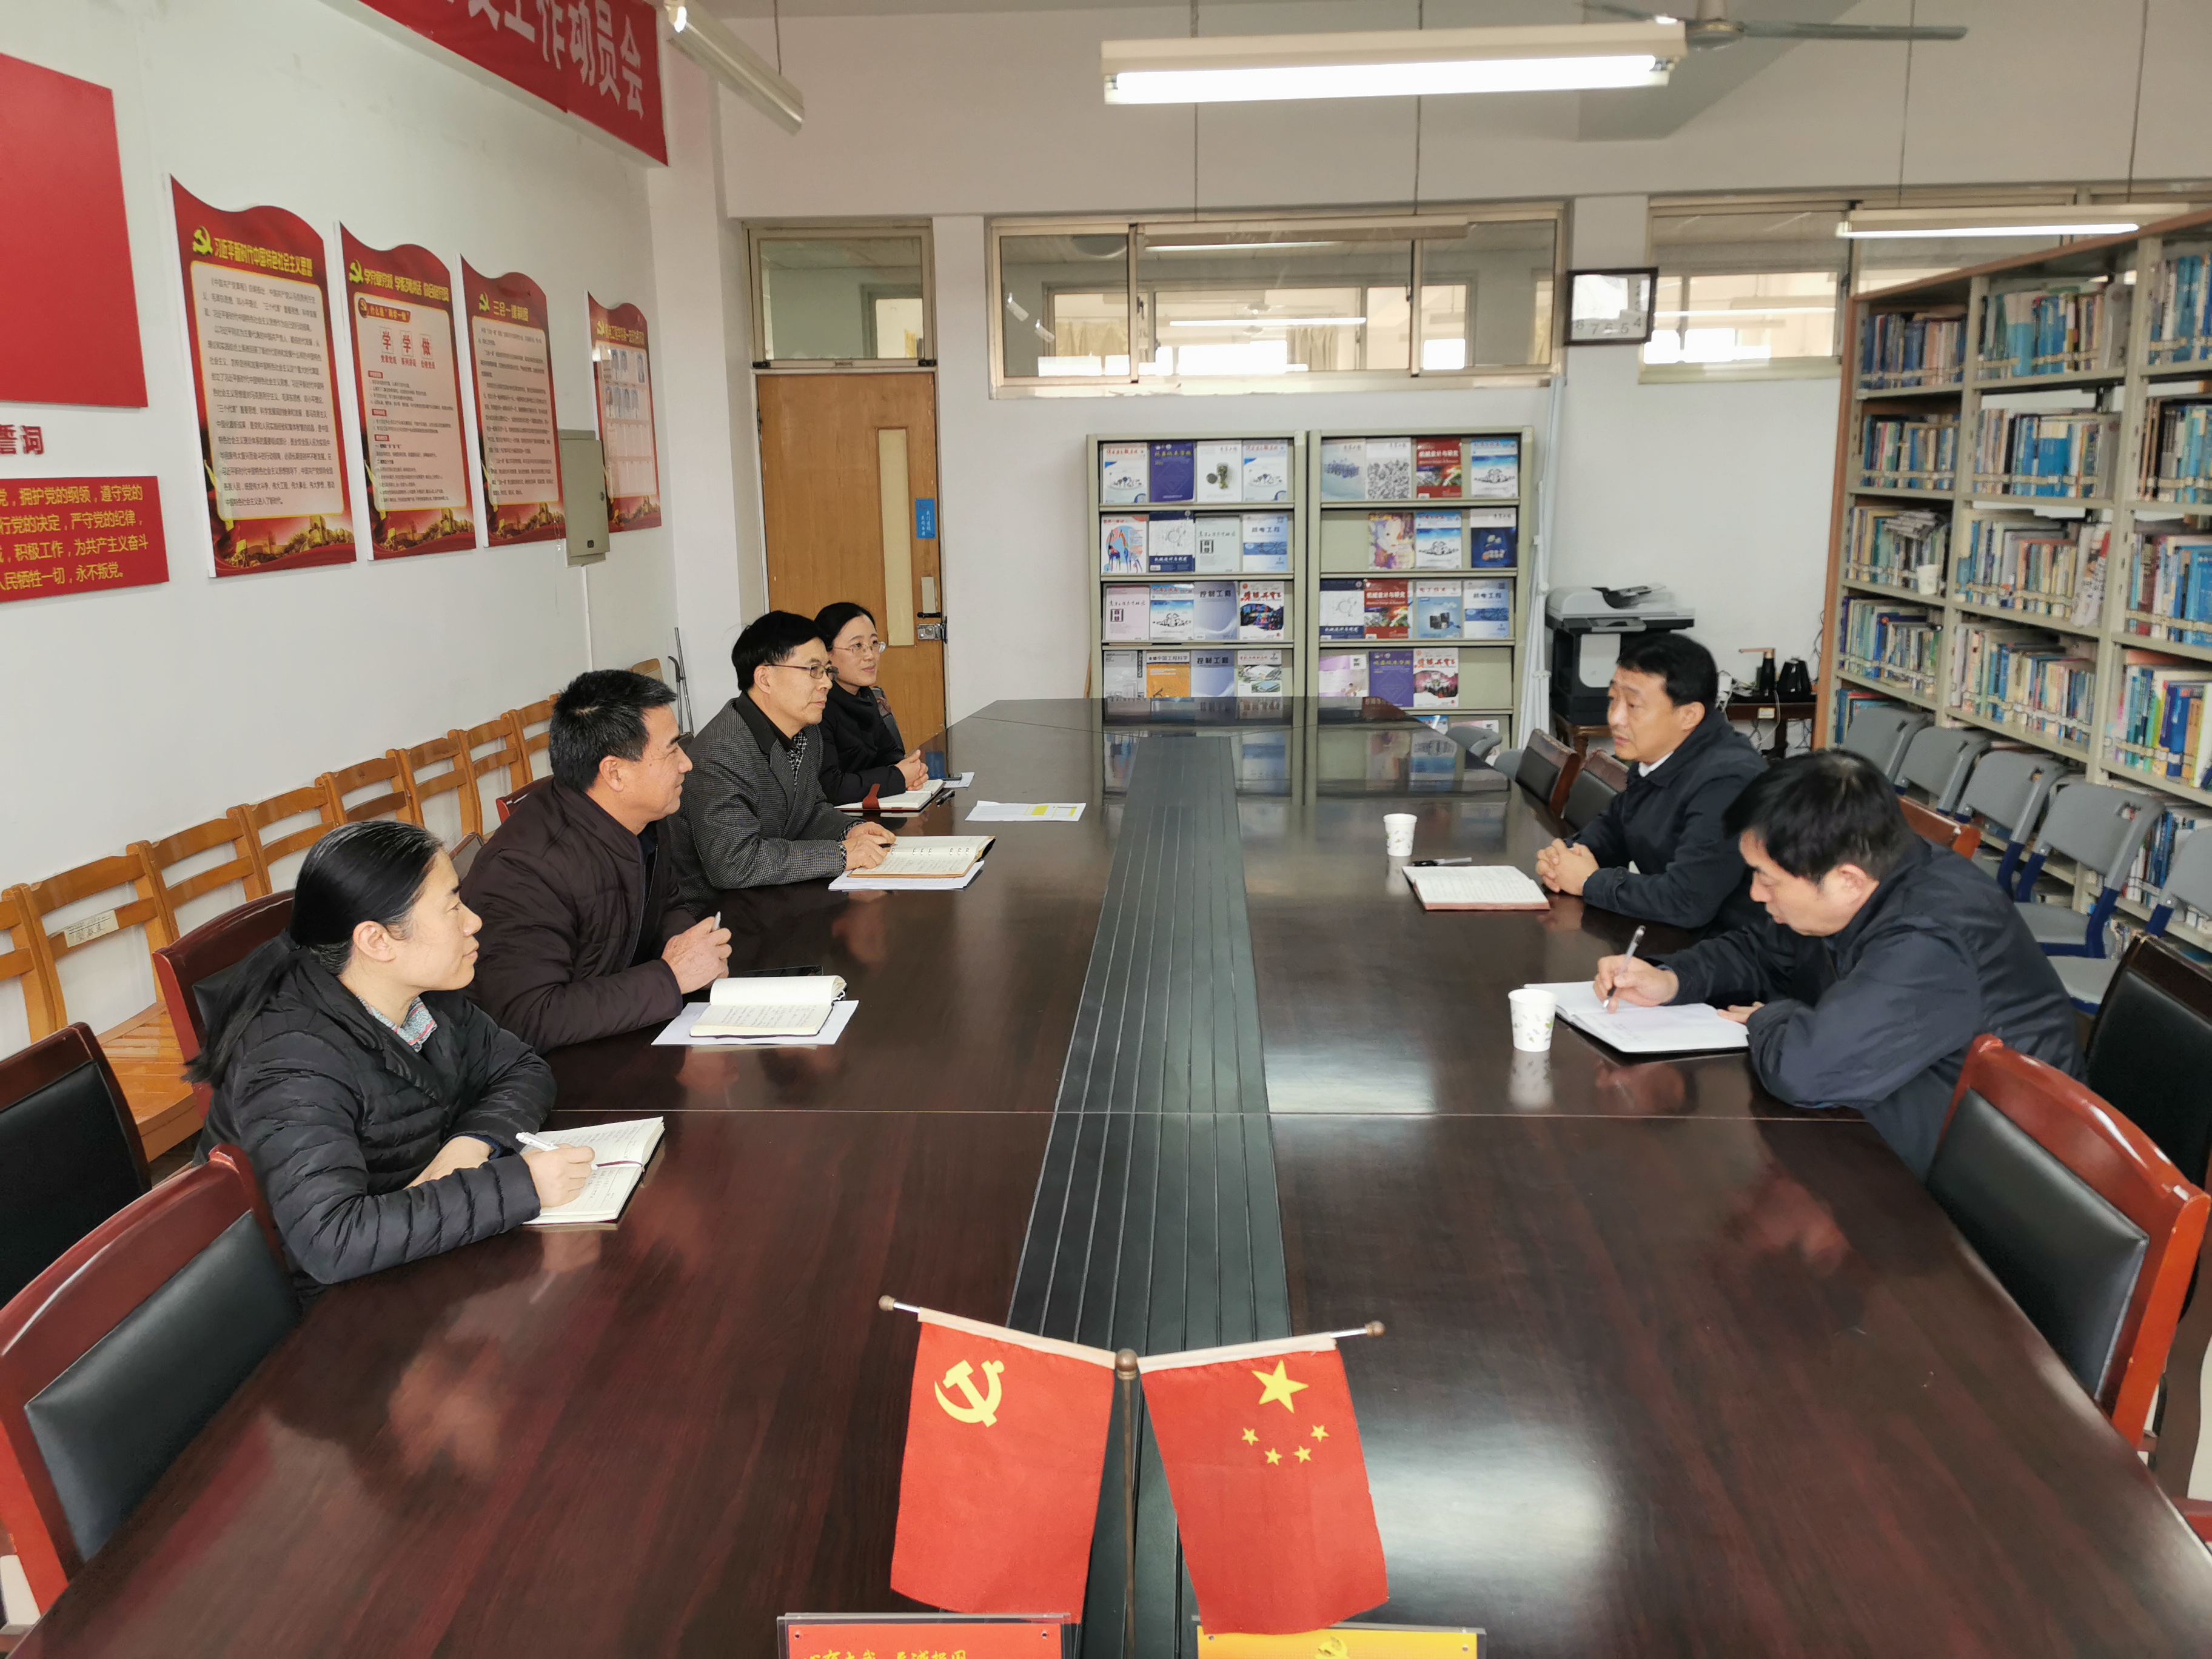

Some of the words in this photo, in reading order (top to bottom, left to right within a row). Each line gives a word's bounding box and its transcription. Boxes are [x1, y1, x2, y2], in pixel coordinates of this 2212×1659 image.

[382, 330, 392, 350] 学
[402, 335, 412, 354] 学
[422, 338, 431, 356] 做
